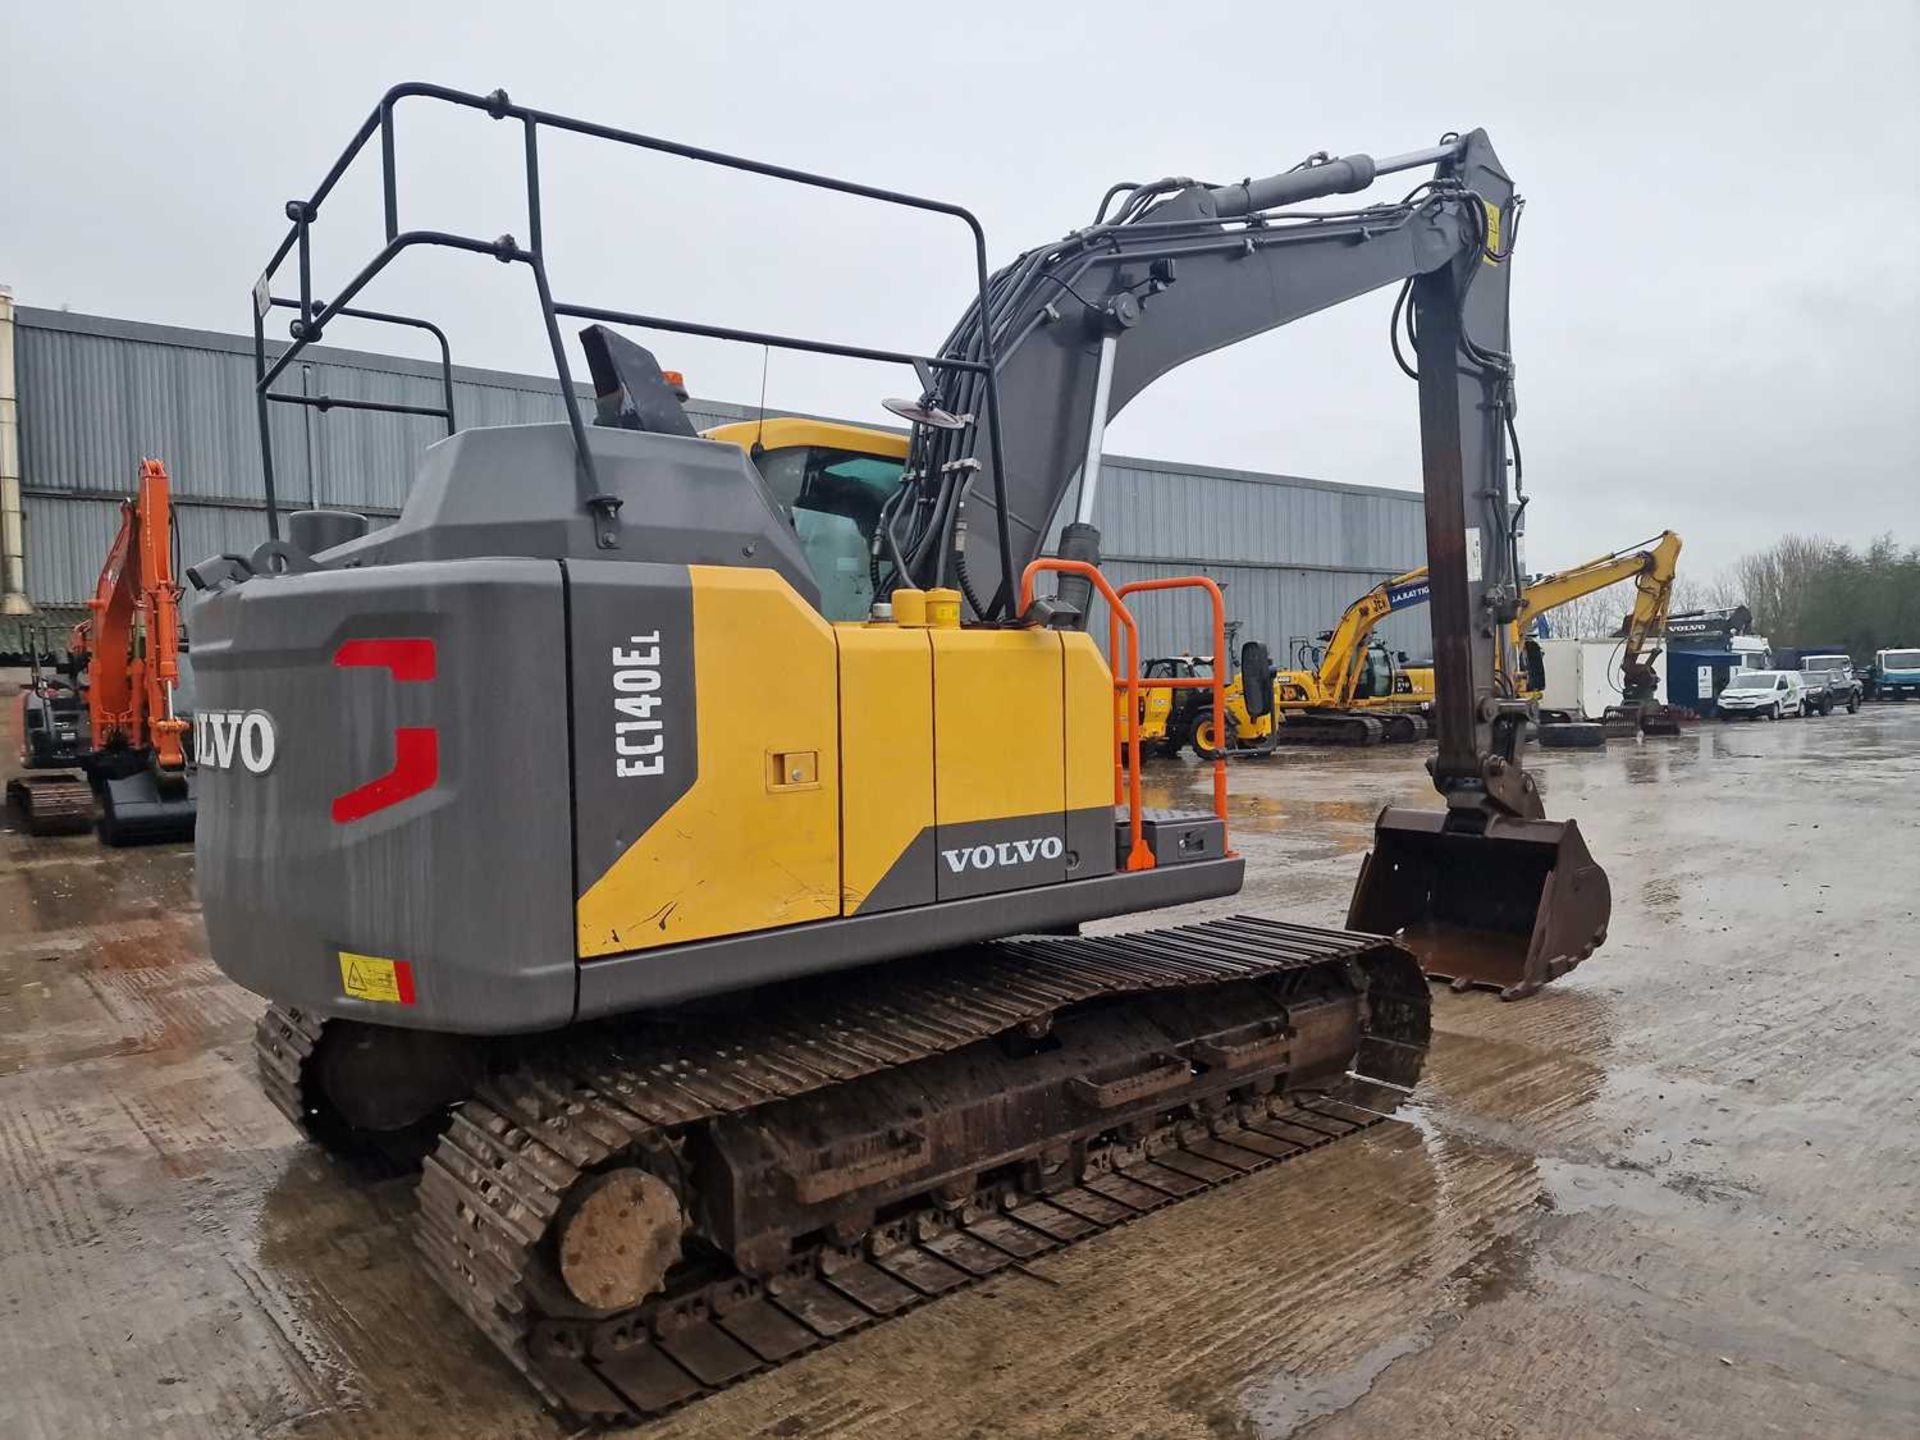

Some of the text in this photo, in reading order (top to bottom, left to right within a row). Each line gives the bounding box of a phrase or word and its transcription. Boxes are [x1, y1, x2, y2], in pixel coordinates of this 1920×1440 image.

[1668, 624, 1706, 632] VOLVO
[612, 630, 664, 778] EC140EL
[193, 713, 275, 773] OLVO
[941, 836, 1063, 873] VOLVO
